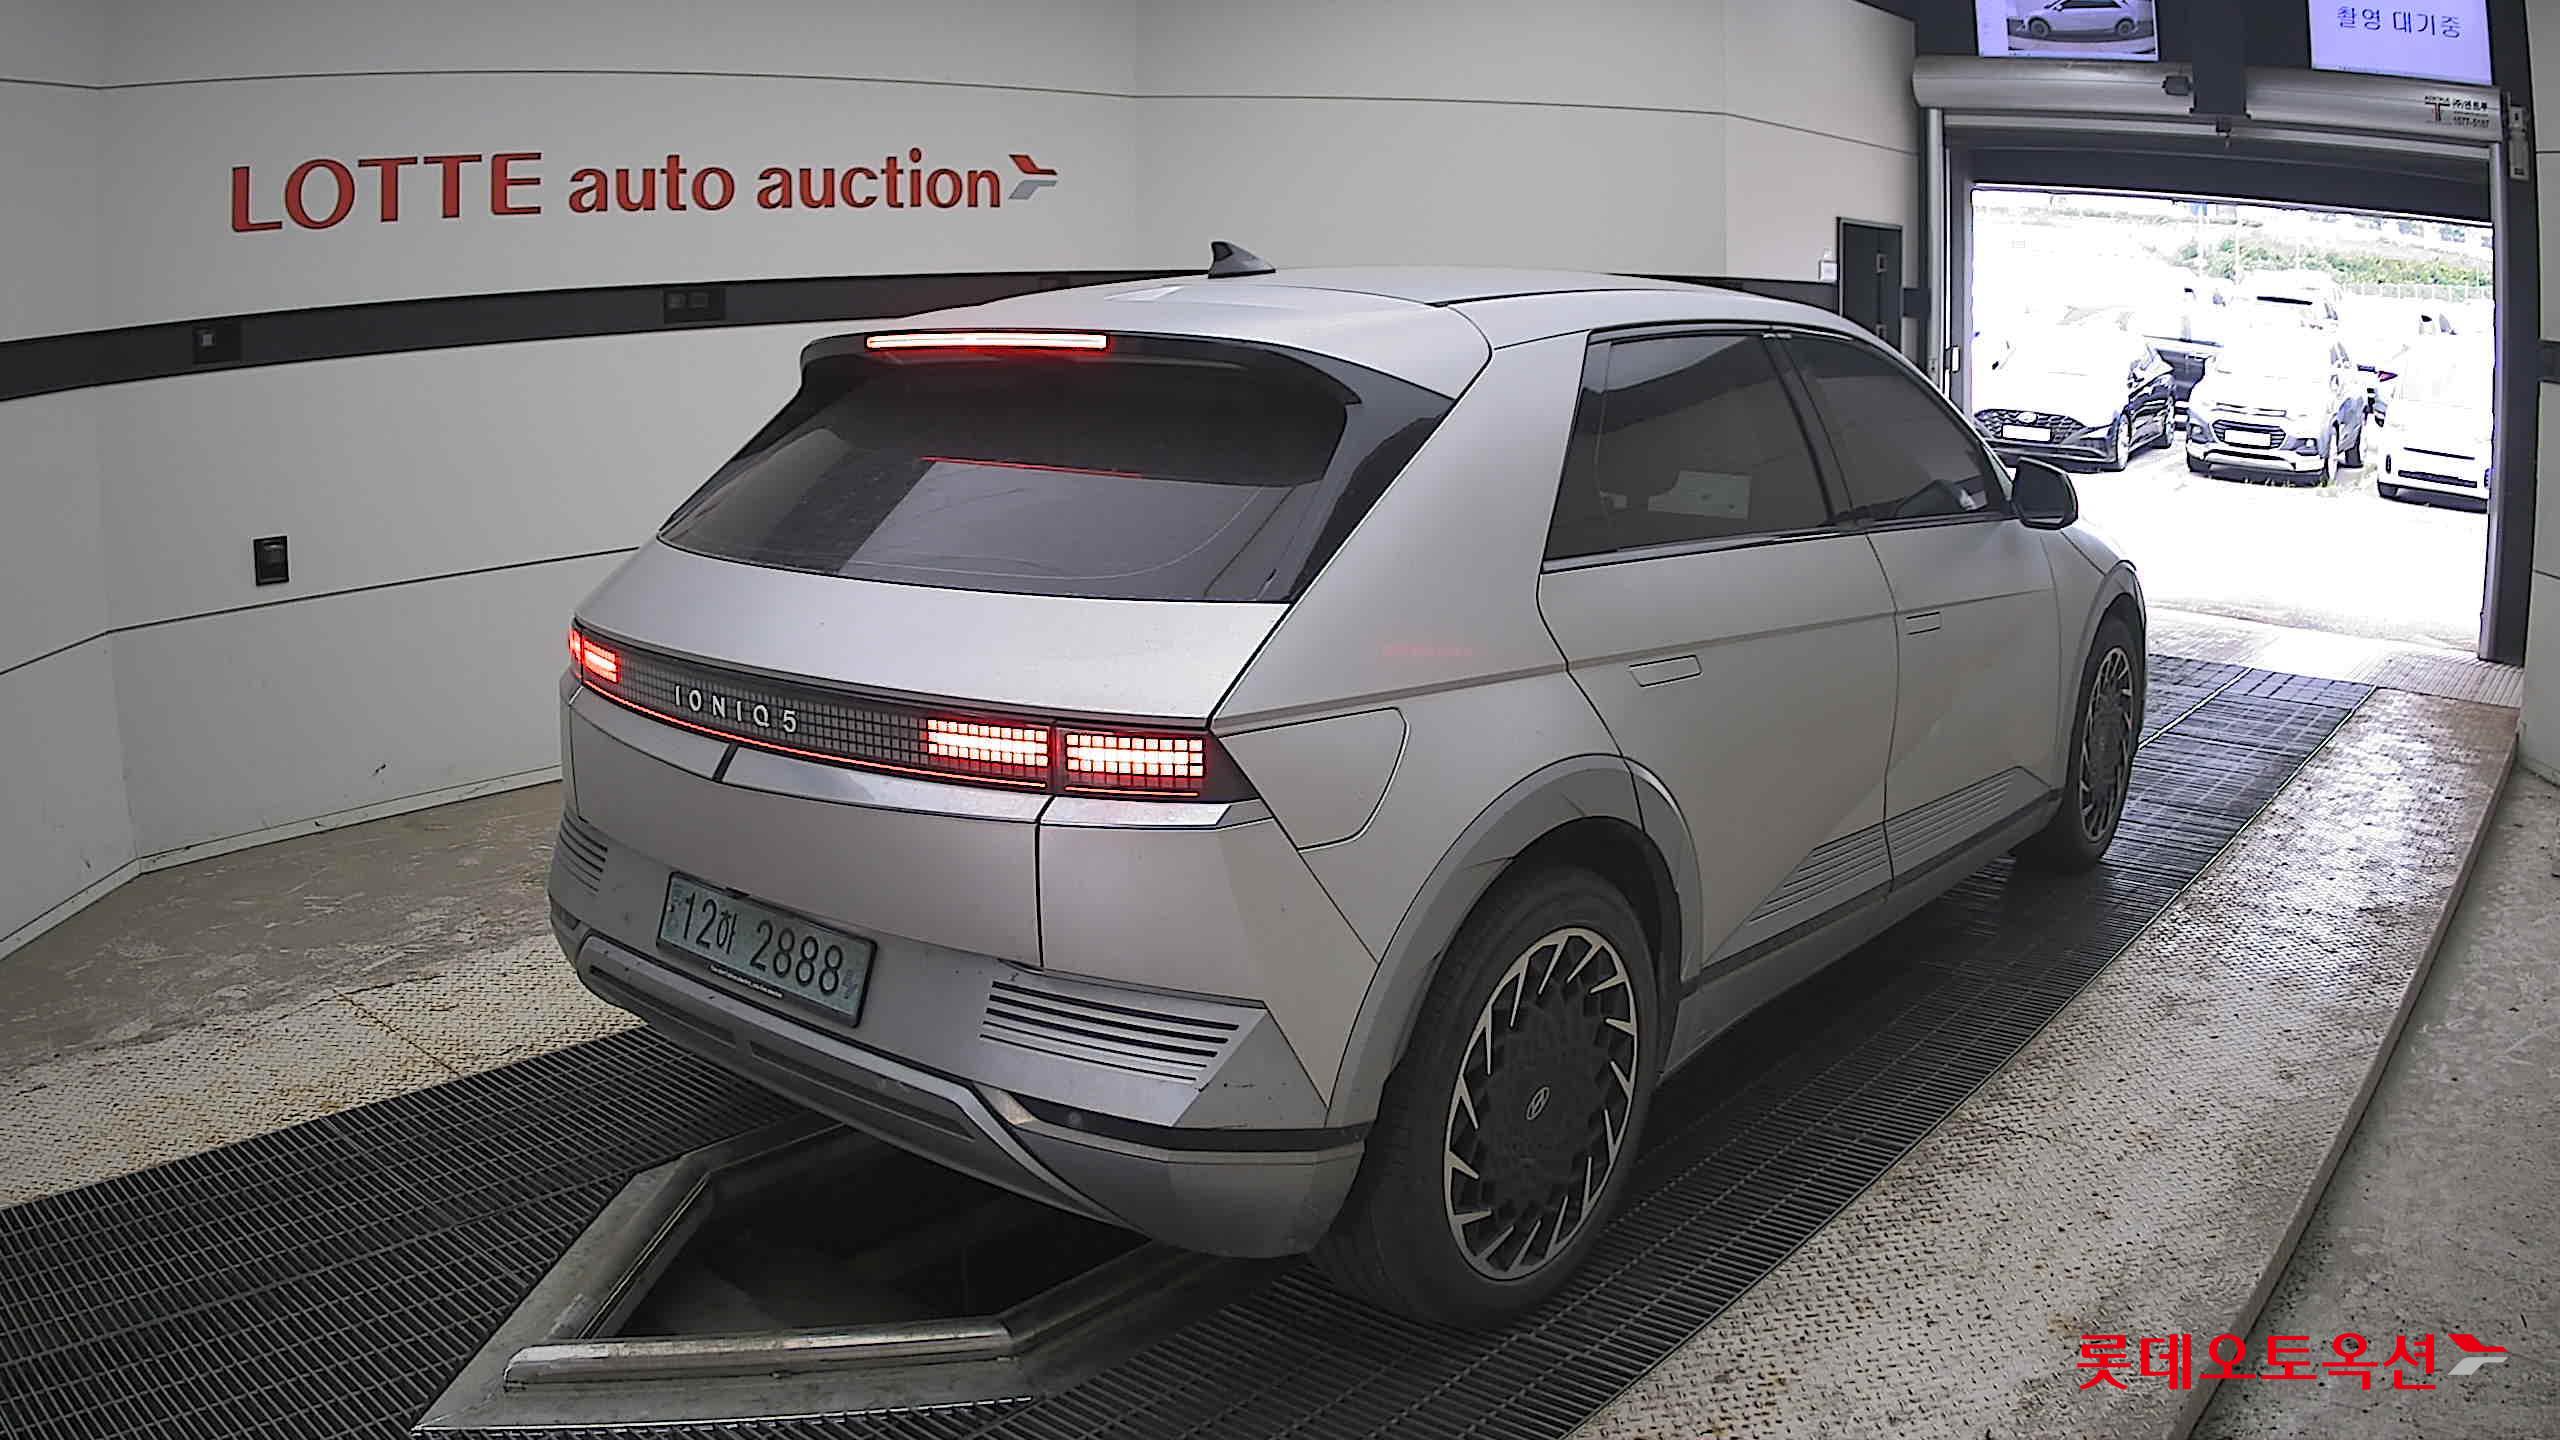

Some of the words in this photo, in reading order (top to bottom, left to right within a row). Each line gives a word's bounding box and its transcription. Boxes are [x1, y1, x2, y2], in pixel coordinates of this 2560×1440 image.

[2338, 7, 2381, 30] 촬영
[2393, 11, 2460, 38] 대기중
[232, 152, 541, 233] LOTTE
[568, 153, 734, 213] auto
[757, 148, 1001, 209] auction
[674, 685, 770, 728] IONIQ
[783, 709, 797, 733] 5
[683, 892, 738, 954] 12하
[750, 920, 843, 996] 2888
